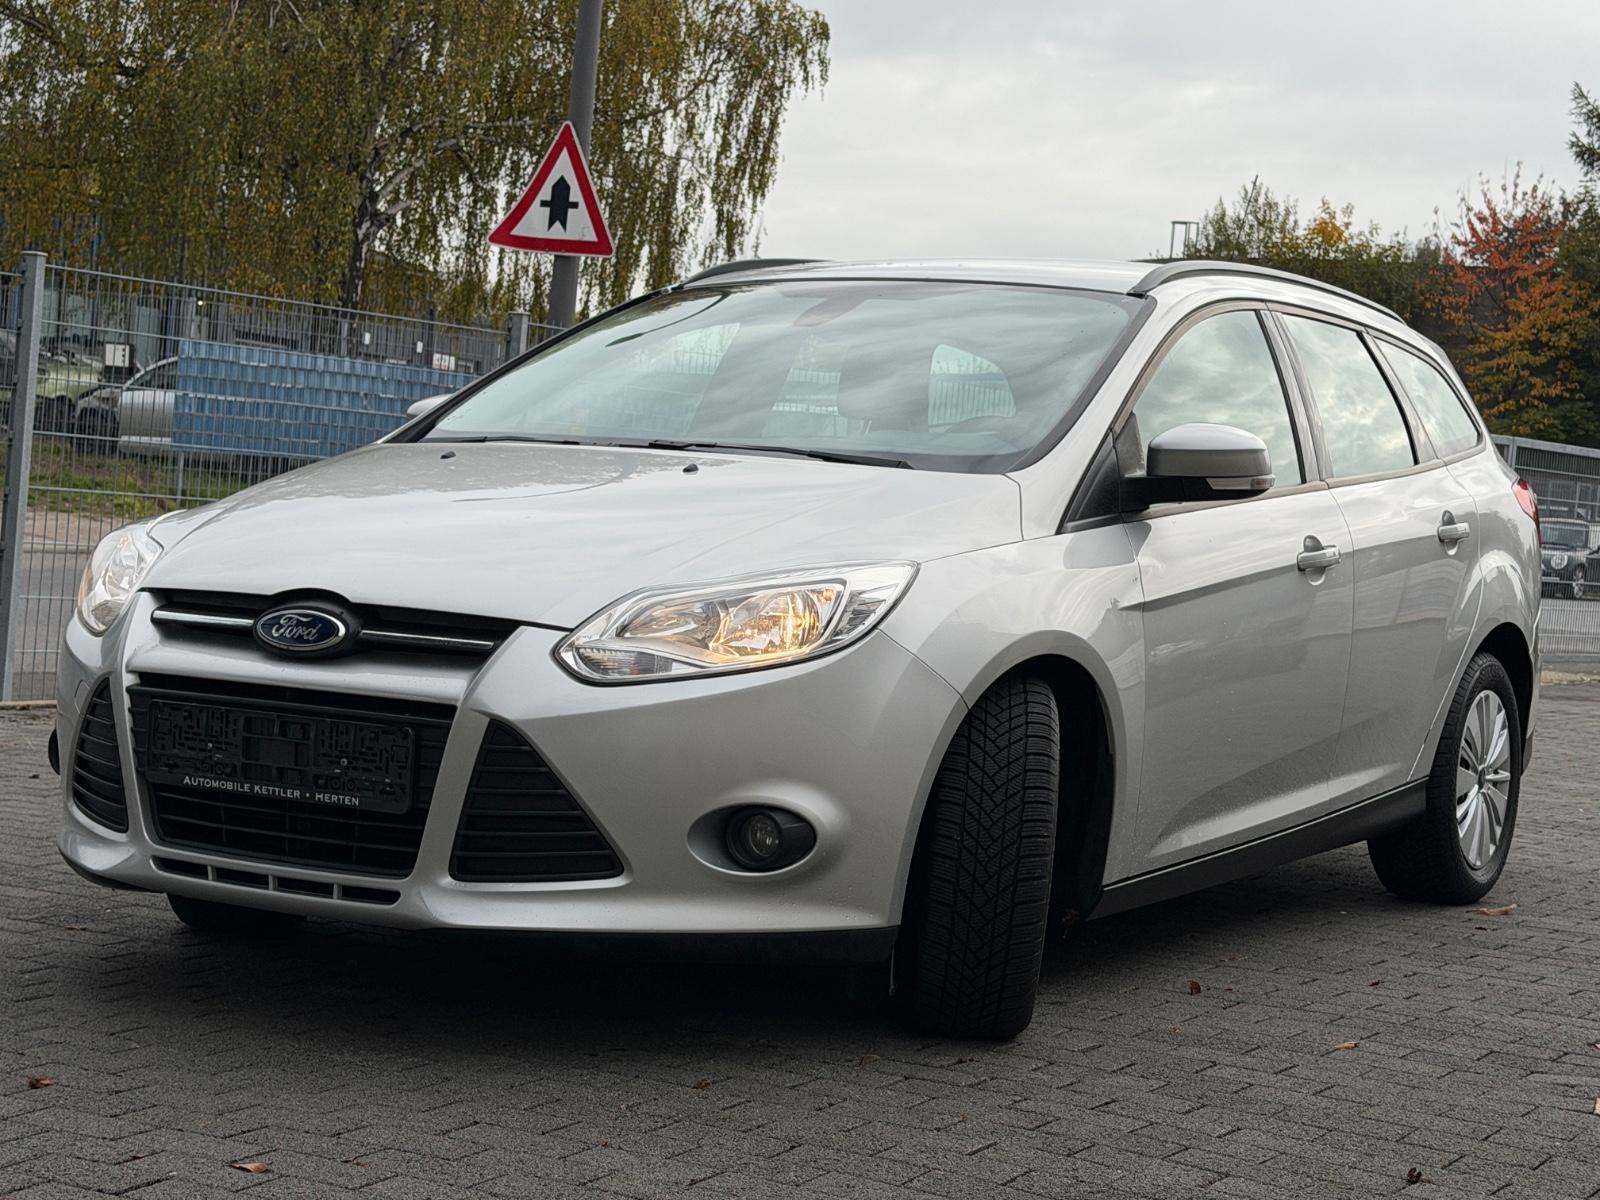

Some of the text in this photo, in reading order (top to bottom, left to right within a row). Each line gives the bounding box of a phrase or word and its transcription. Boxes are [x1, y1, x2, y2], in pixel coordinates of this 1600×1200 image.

[271, 614, 322, 641] Ford
[183, 775, 360, 807] AUTOMOBILE KETTLER HERTEN
